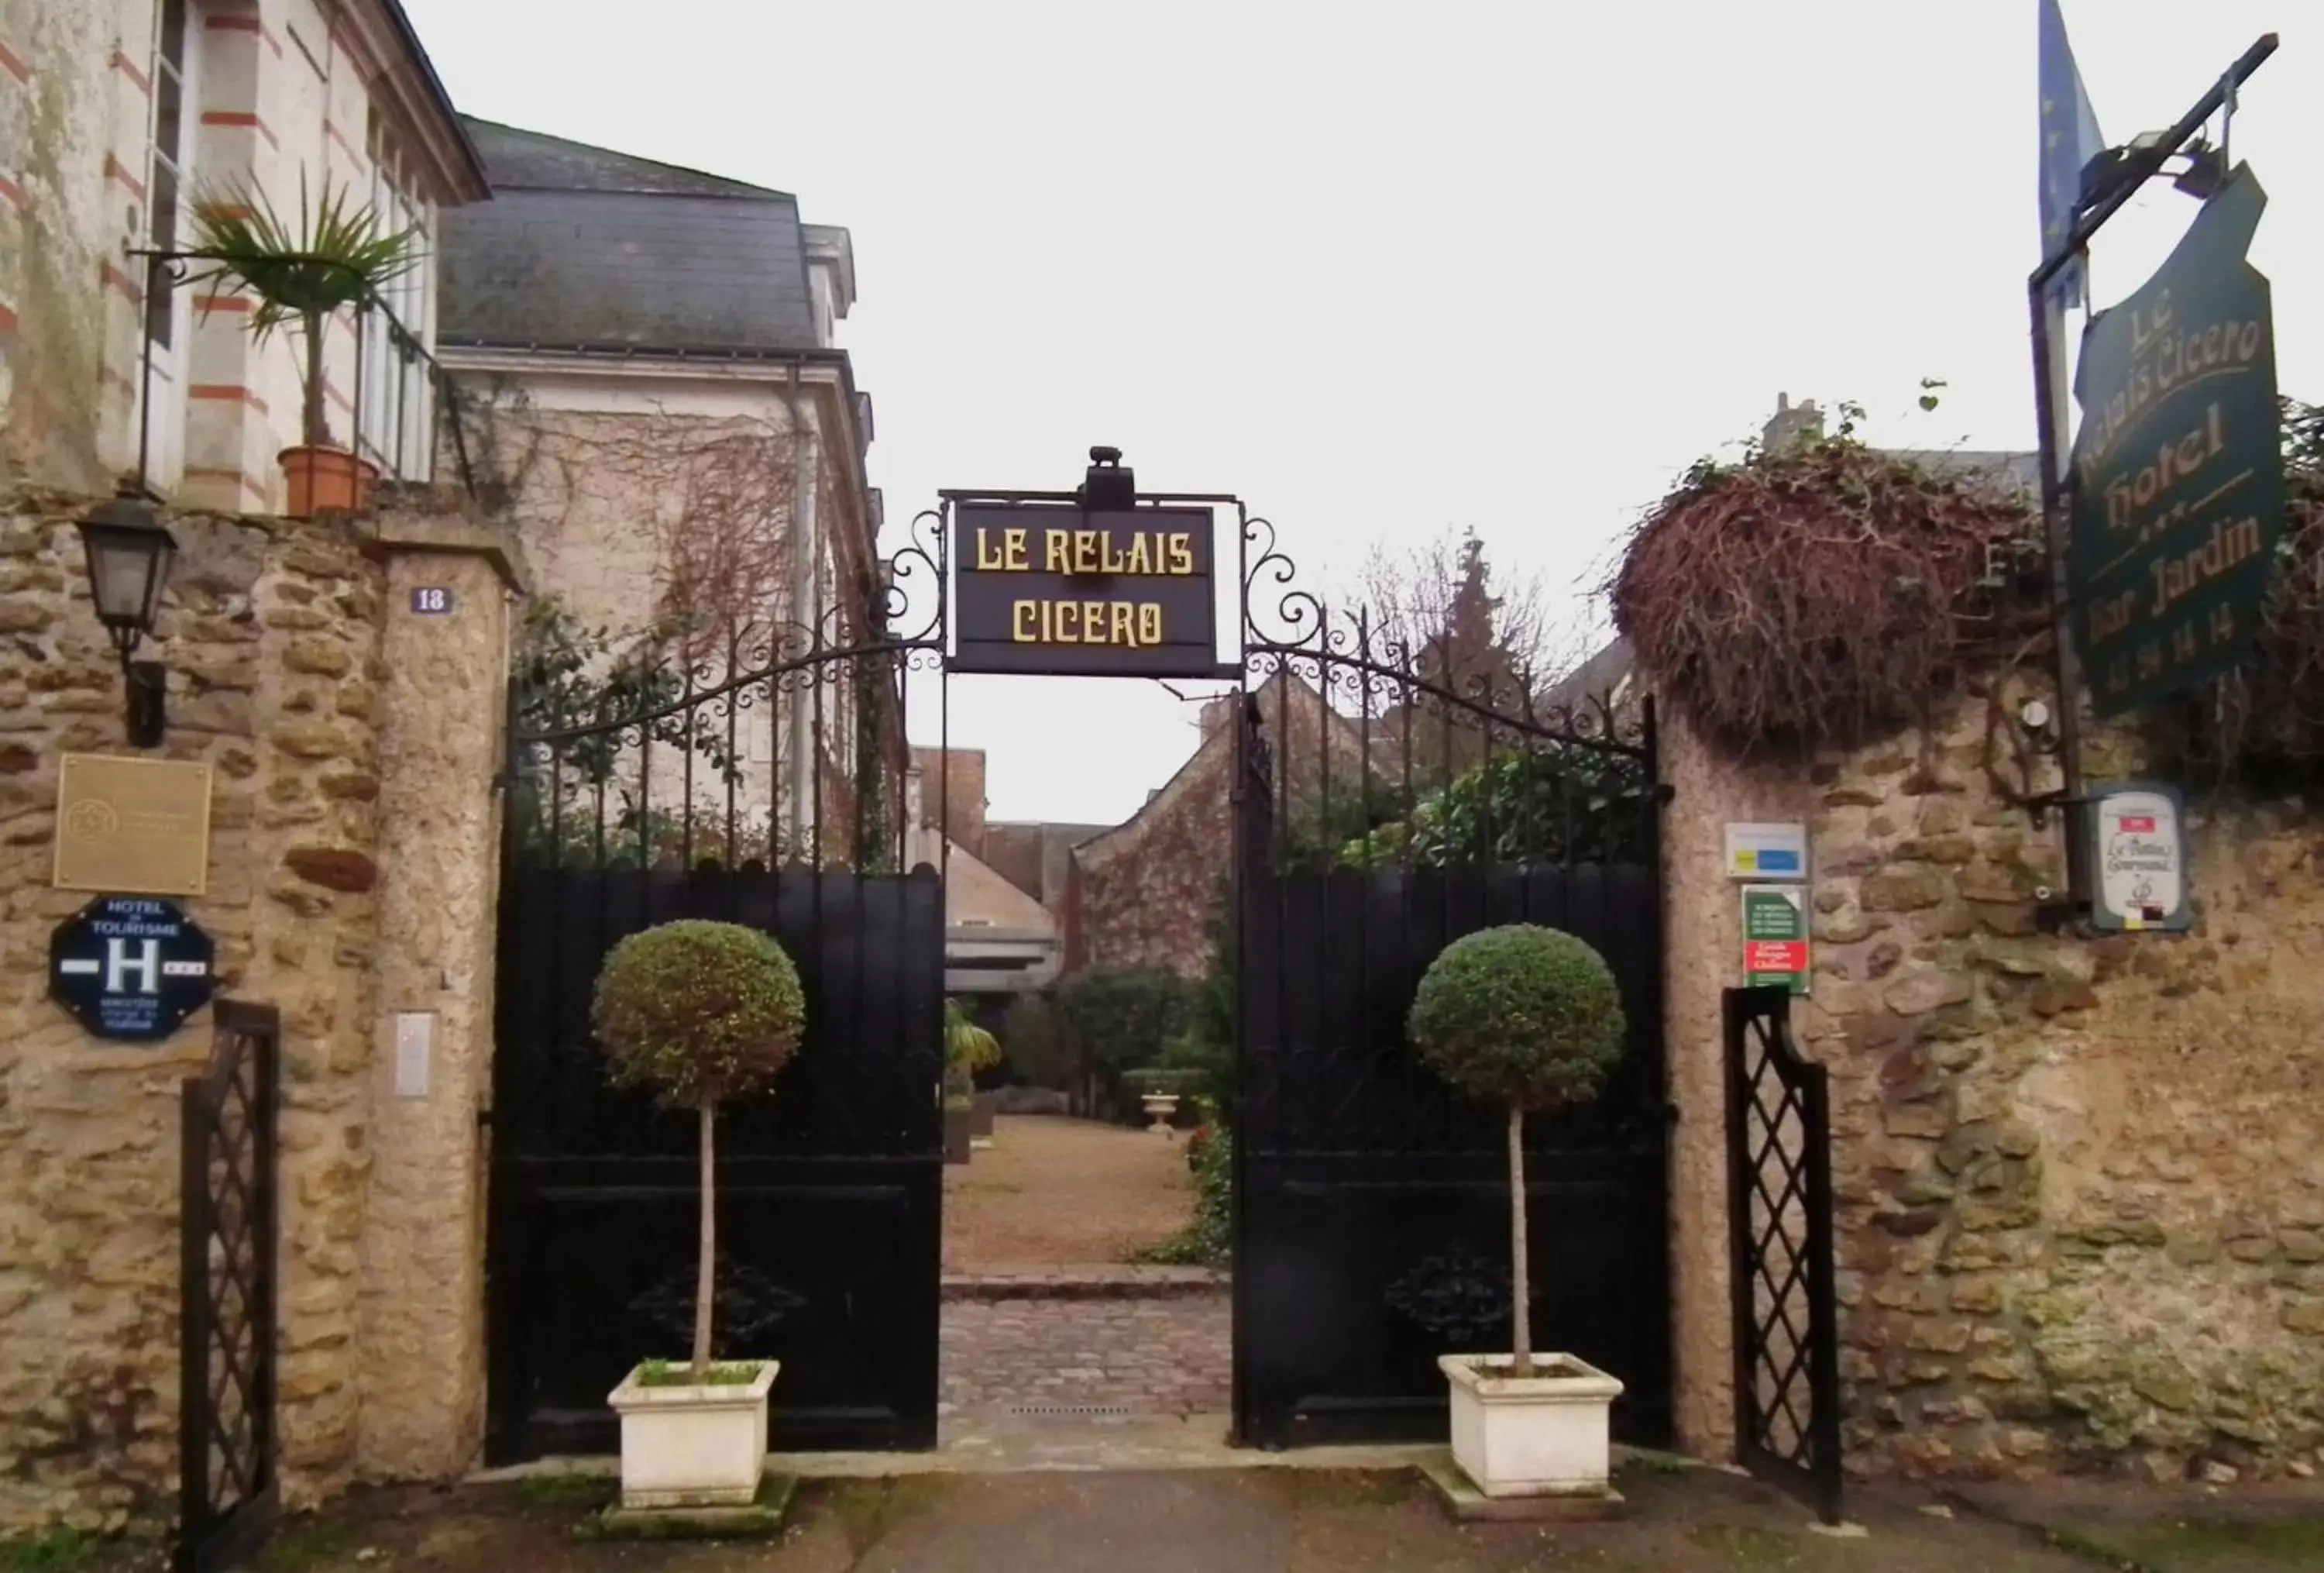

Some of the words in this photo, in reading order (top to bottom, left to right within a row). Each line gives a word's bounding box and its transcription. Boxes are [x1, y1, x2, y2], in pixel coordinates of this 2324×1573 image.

[2132, 287, 2172, 353] Le
[2156, 319, 2260, 389] Cicero
[977, 527, 1029, 570] LE
[1045, 528, 1193, 576] RELAIS
[2149, 515, 2261, 618] Jardin
[418, 588, 445, 611] 18
[1012, 600, 1161, 648] CICERO
[91, 921, 180, 937] TOURISME
[105, 938, 160, 993] H
